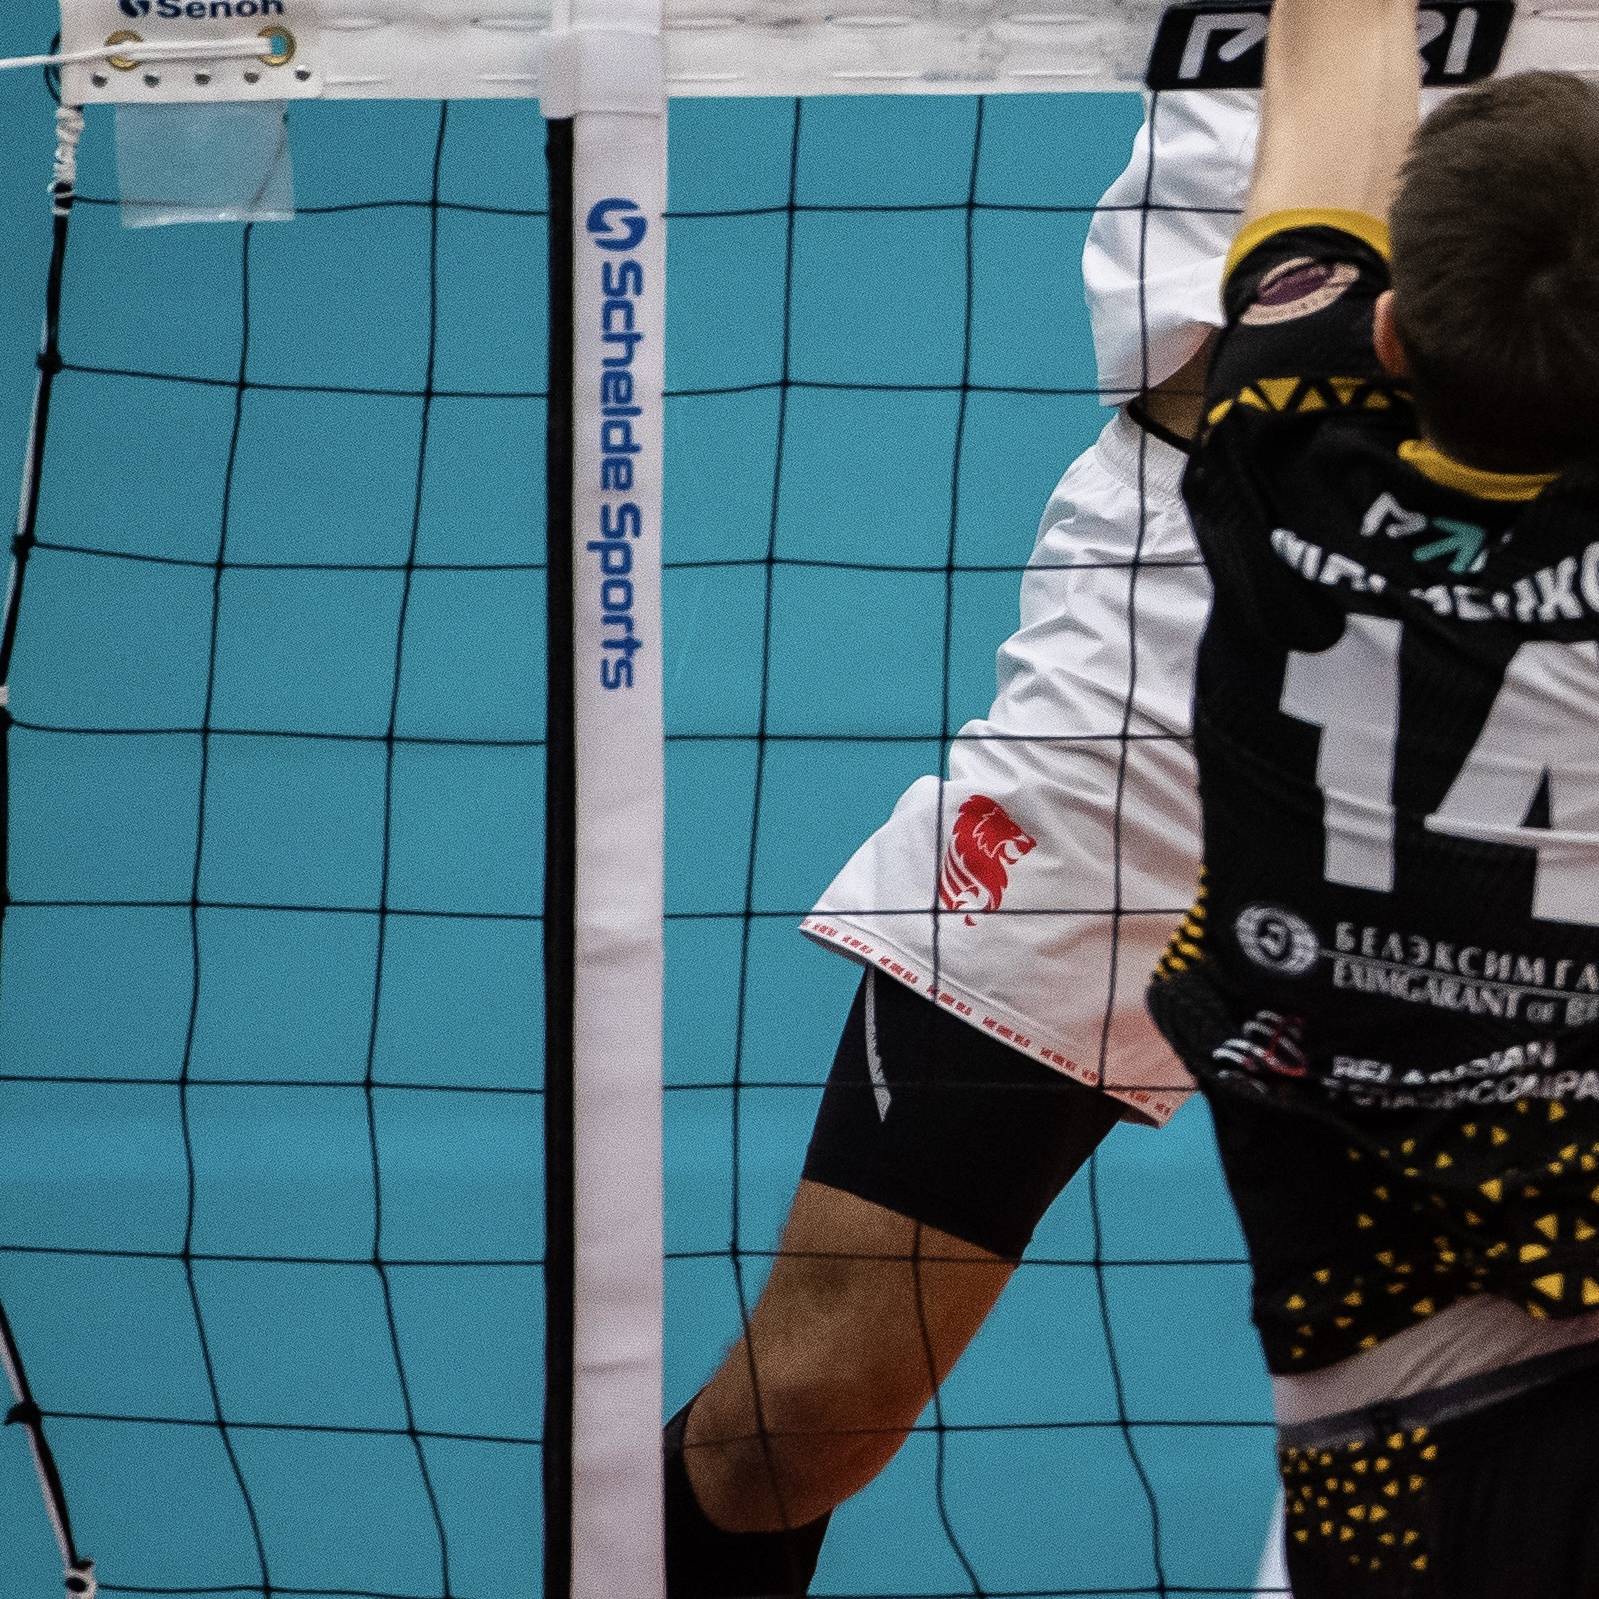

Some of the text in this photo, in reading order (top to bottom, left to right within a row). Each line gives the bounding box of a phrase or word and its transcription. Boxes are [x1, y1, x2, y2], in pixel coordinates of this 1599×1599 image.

[1178, 7, 1479, 80] PI
[586, 259, 645, 691] Schelde Sports
[1360, 492, 1513, 575] PA
